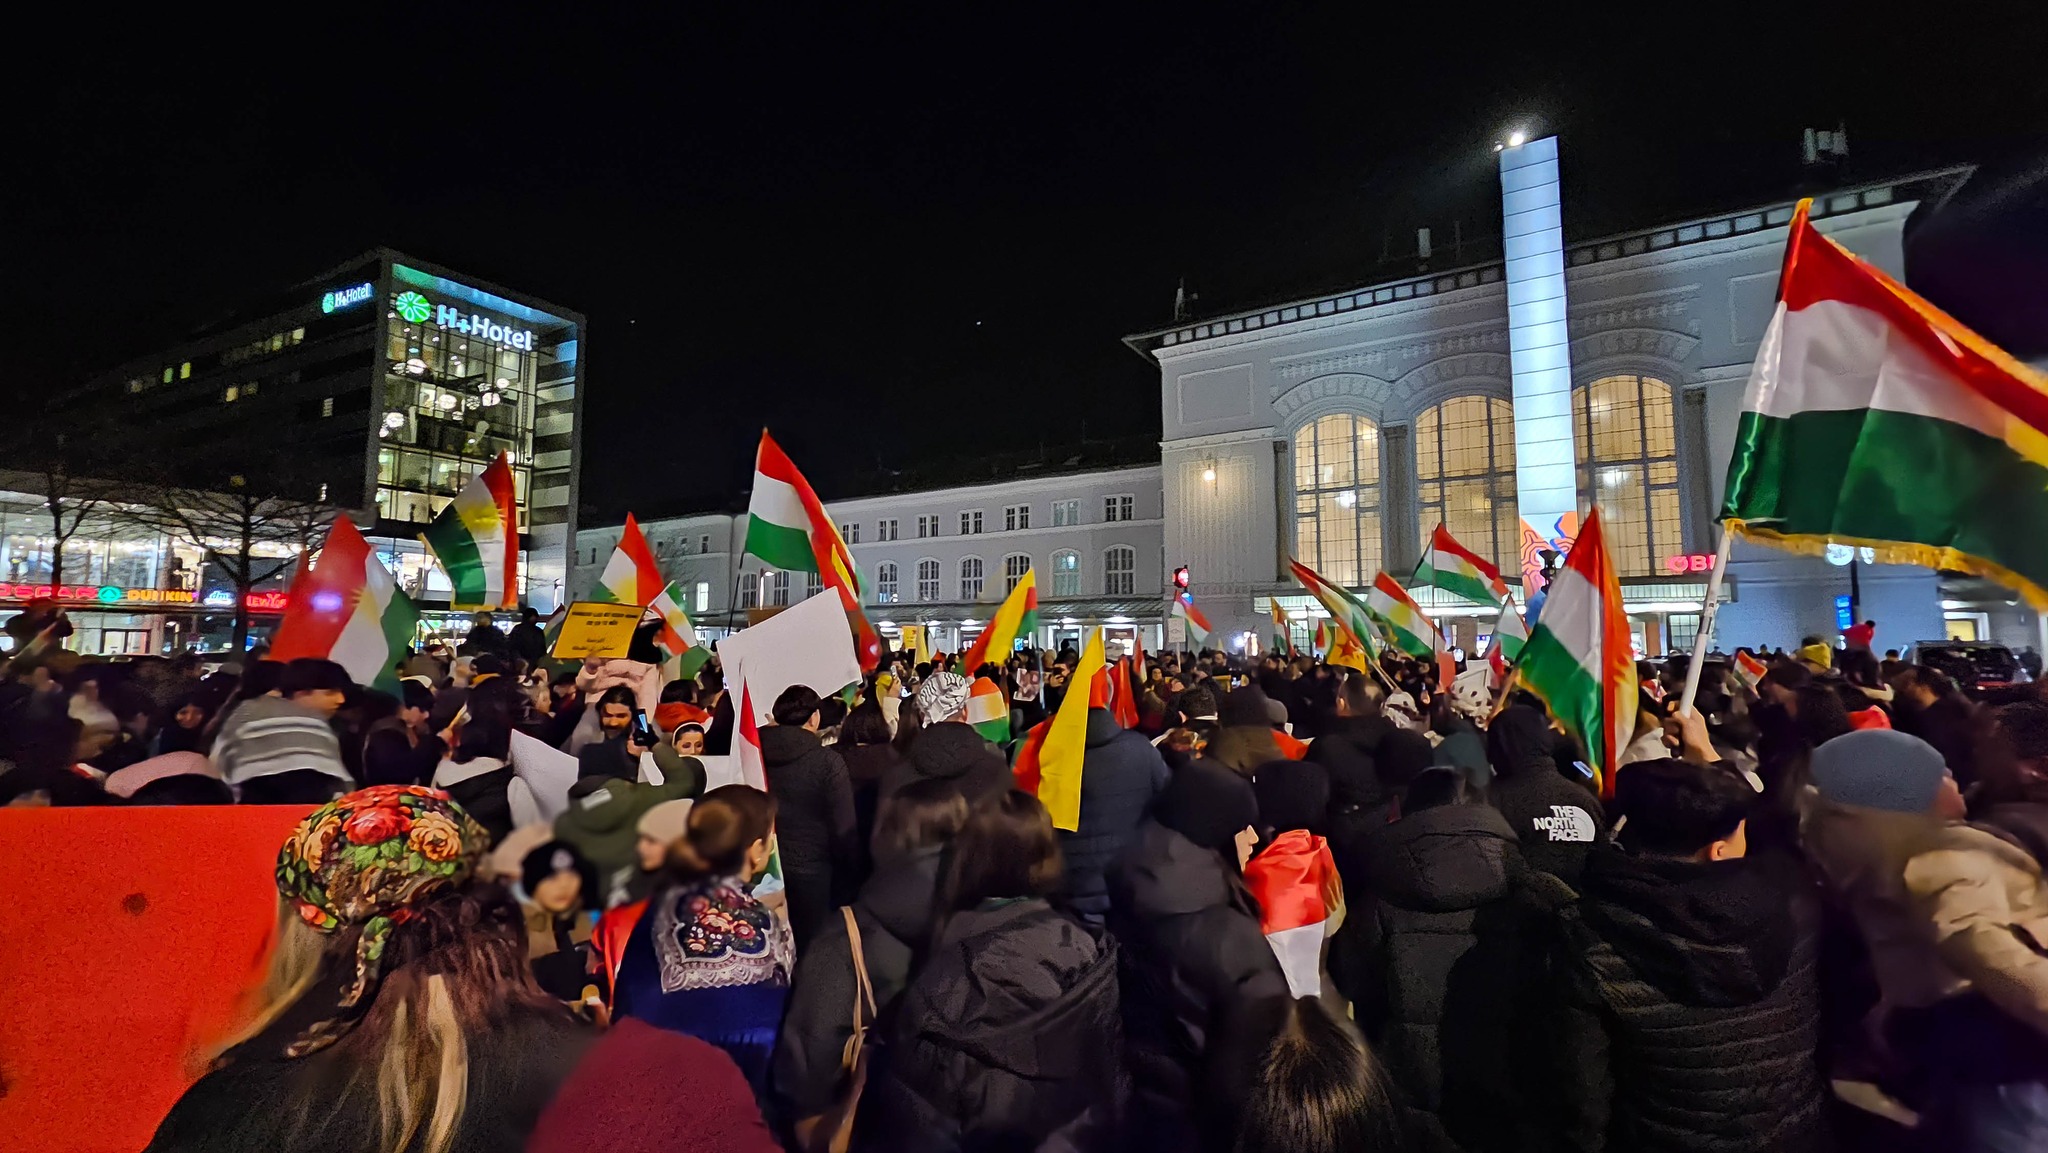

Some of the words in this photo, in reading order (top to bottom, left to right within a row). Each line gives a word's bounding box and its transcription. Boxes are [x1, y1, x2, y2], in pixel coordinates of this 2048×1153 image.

[436, 303, 533, 351] H+Hotel
[1549, 805, 1574, 818] THE
[1533, 816, 1576, 831] NORTH
[1548, 828, 1579, 842] FACE
